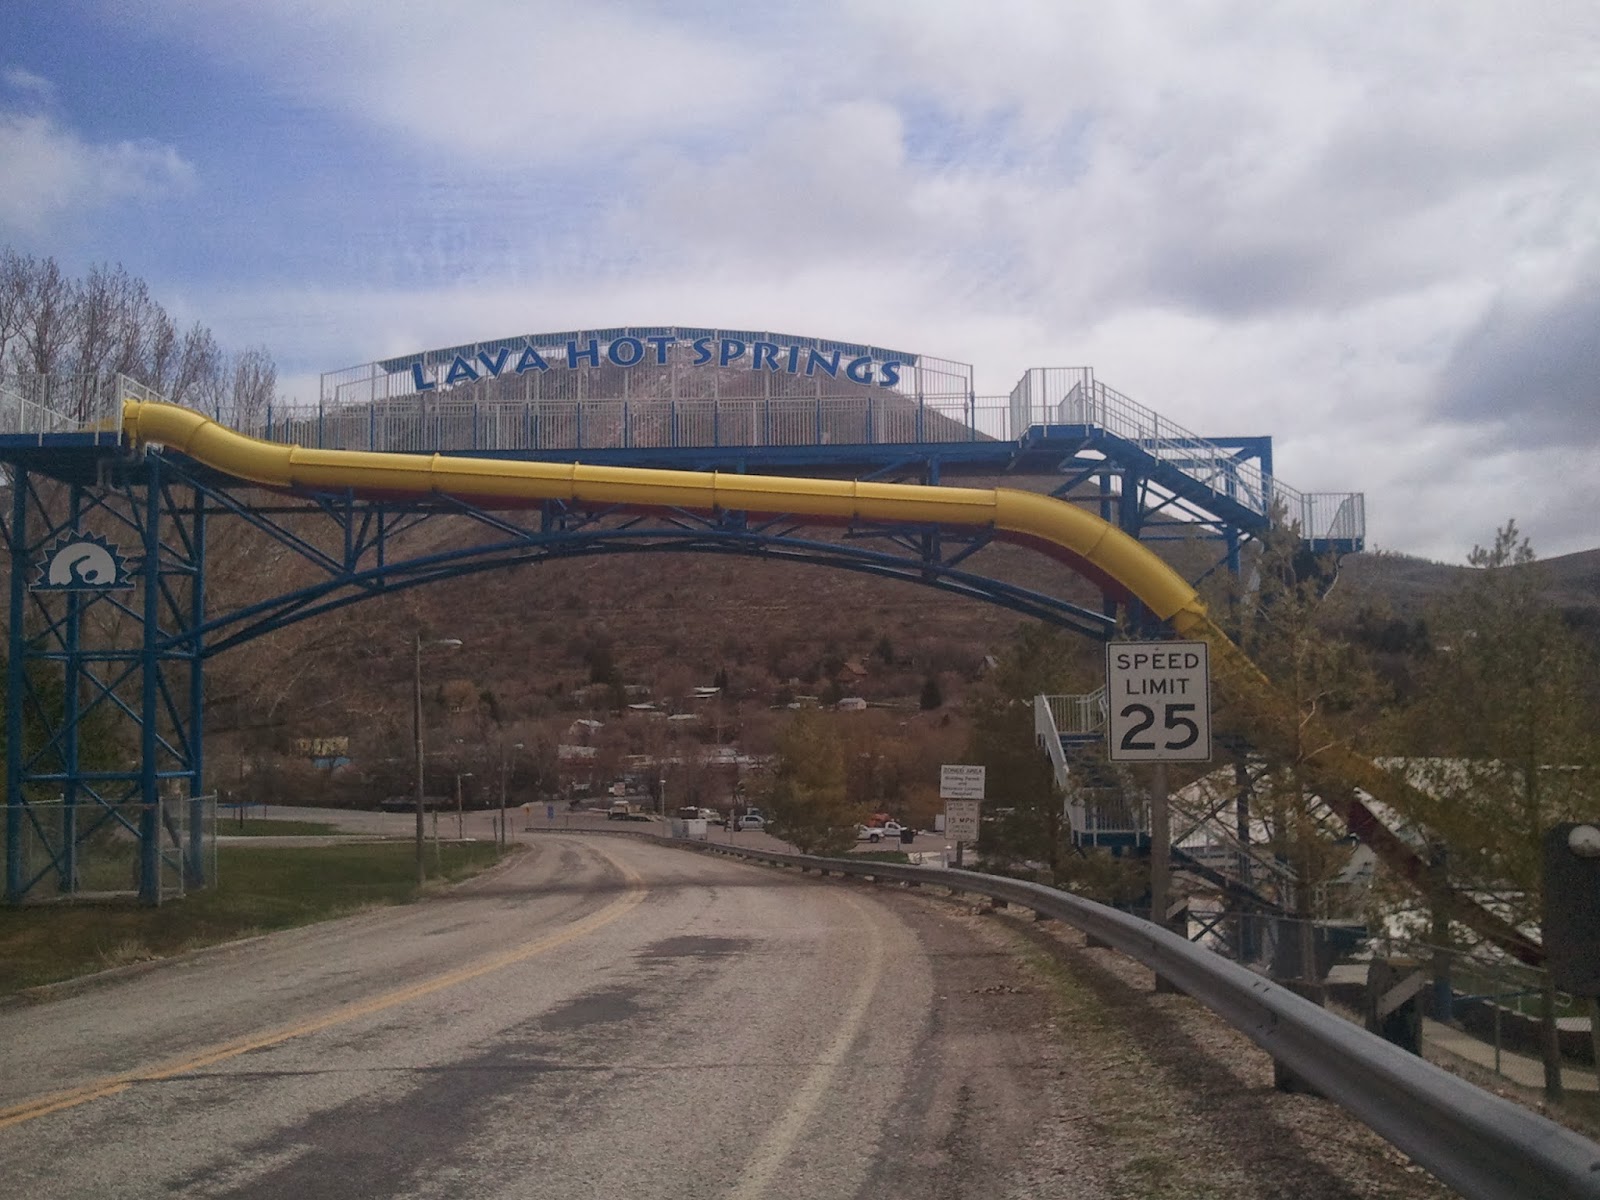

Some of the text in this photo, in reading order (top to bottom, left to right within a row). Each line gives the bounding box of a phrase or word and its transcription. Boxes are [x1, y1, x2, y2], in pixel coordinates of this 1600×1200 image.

[411, 336, 901, 392] LAVA HOT SPRINGS
[1117, 653, 1199, 670] SPEED
[1126, 678, 1190, 695] LIMIT
[1120, 703, 1199, 750] 25
